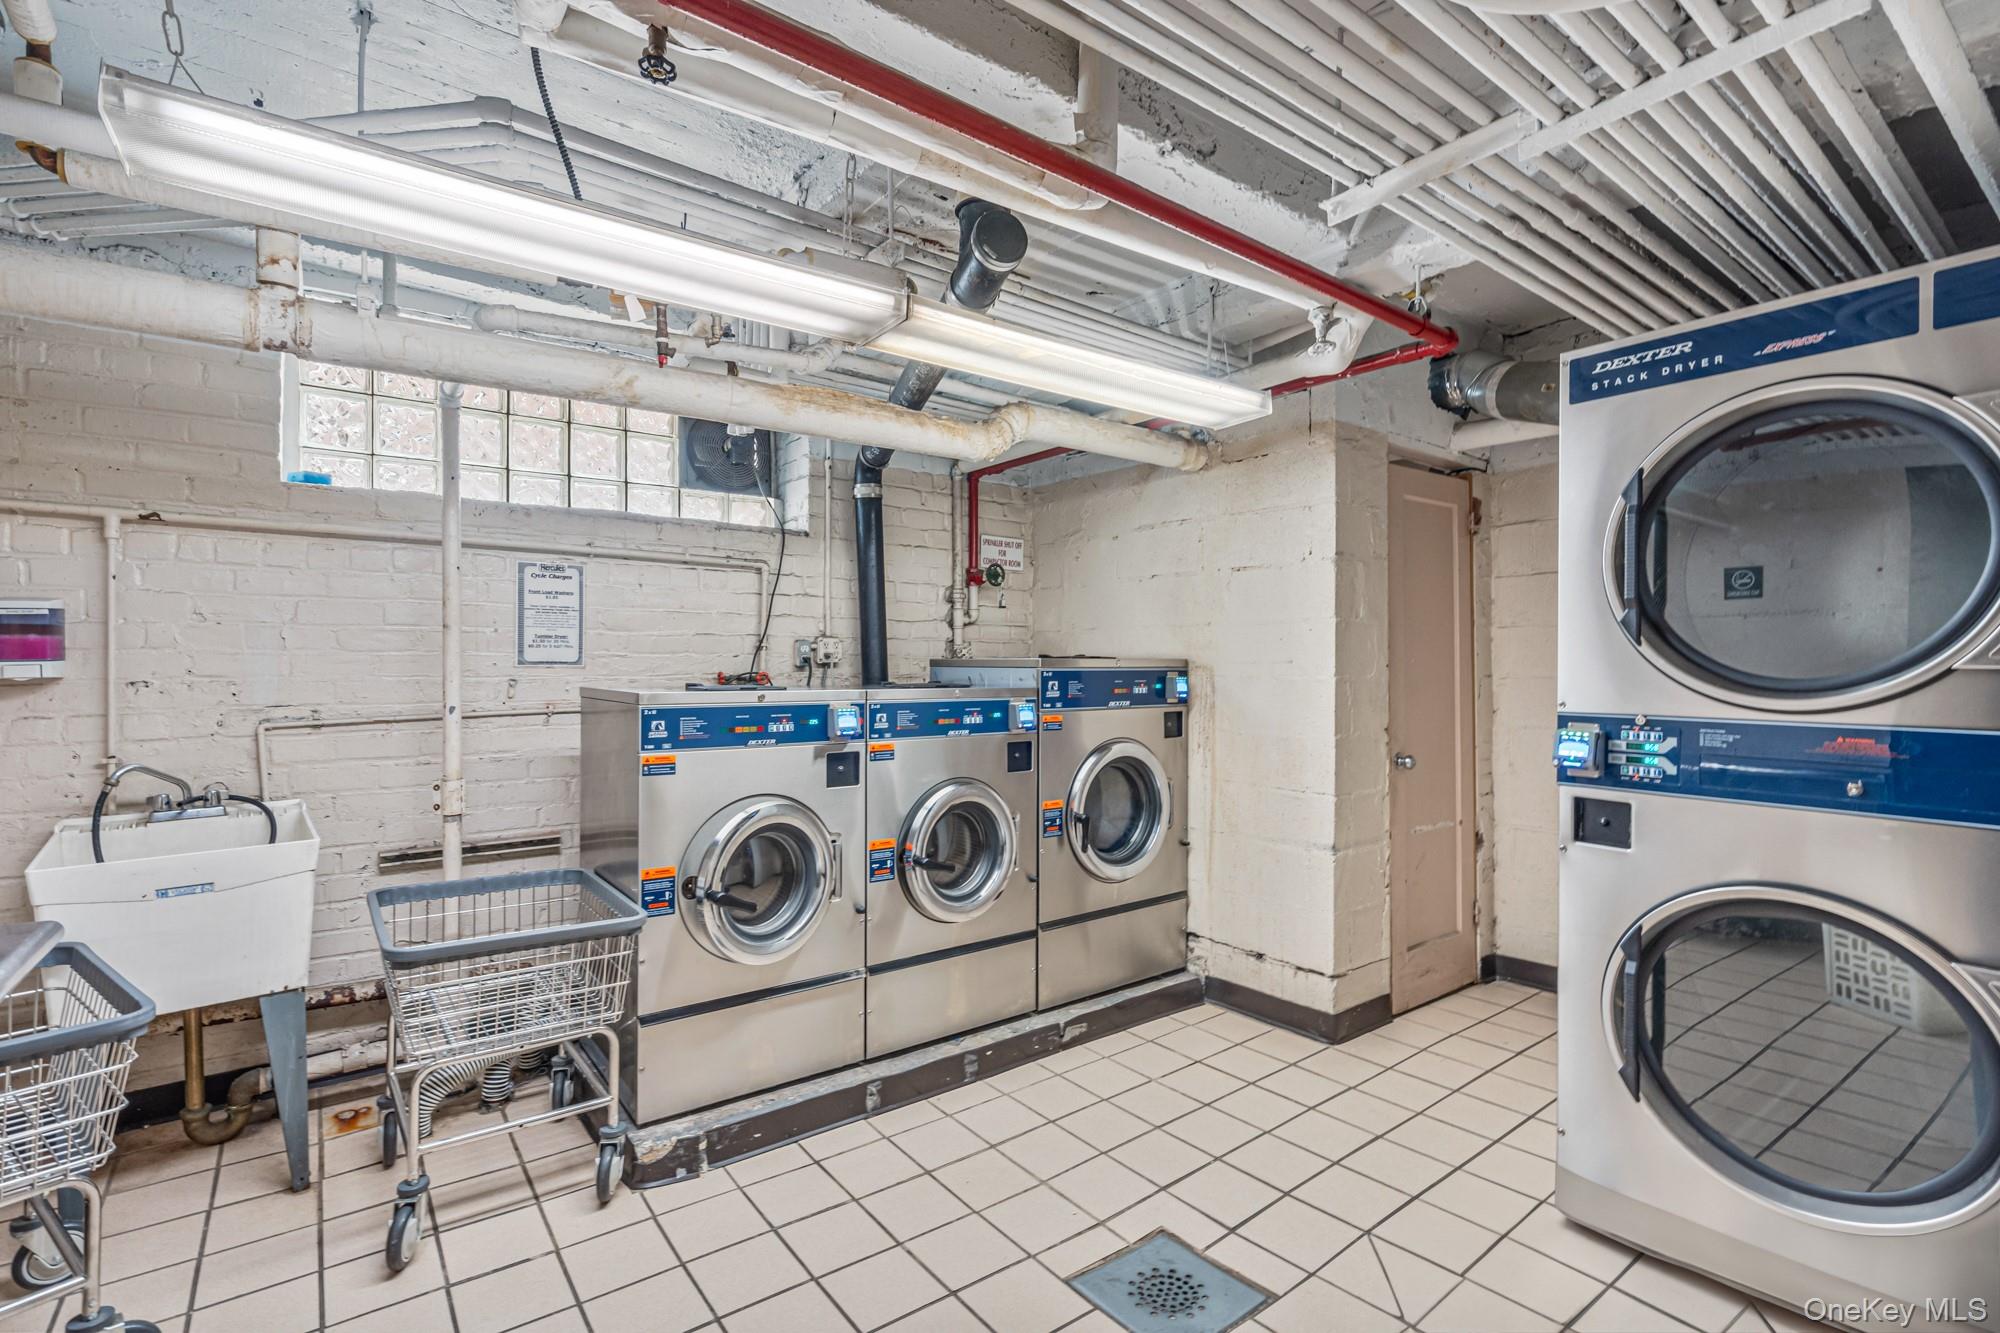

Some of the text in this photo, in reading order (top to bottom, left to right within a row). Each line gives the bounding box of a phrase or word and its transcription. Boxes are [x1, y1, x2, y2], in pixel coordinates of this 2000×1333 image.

[1592, 341, 1693, 374] DEXTER
[1761, 331, 1827, 355] EXPRESS
[1591, 355, 1723, 391] STACK DRYER
